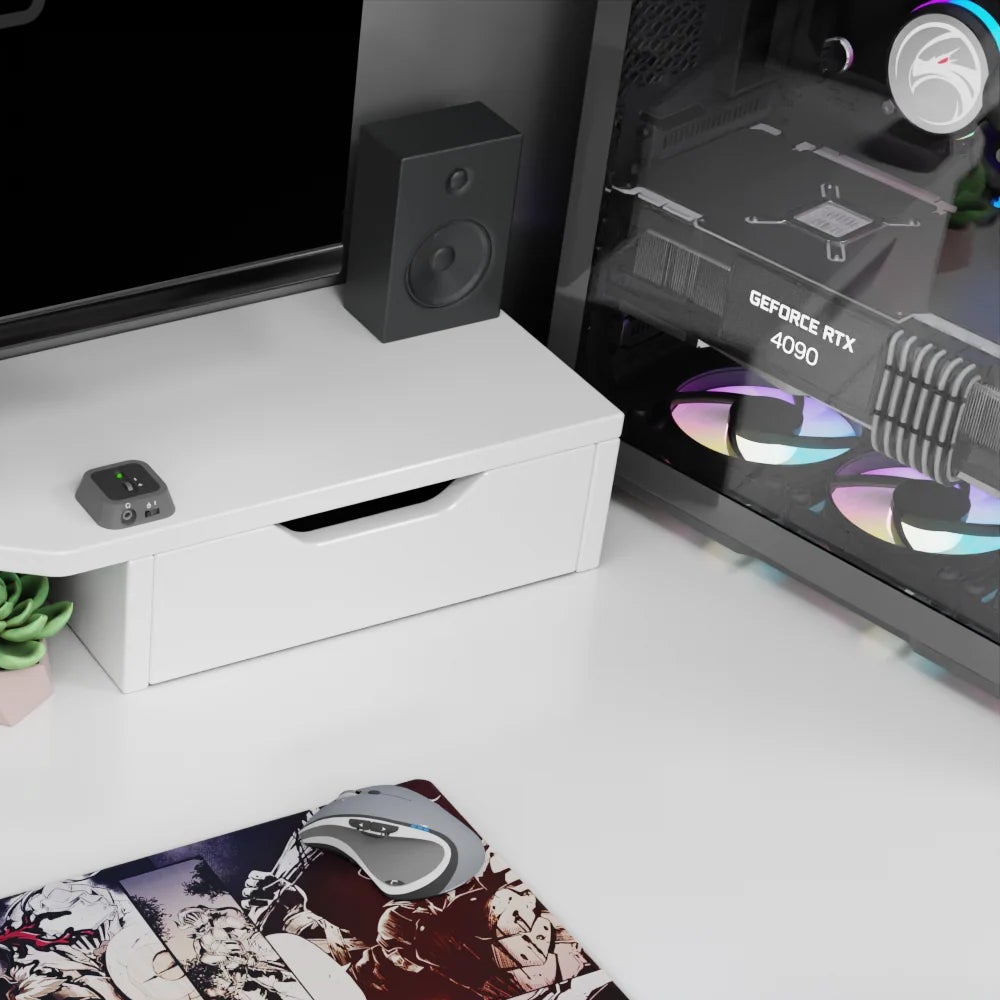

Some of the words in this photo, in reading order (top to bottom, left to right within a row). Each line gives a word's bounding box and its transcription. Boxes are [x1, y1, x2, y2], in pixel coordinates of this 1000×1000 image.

[749, 288, 819, 335] GEFORCE
[822, 324, 857, 354] RTX
[770, 331, 819, 367] 4090
